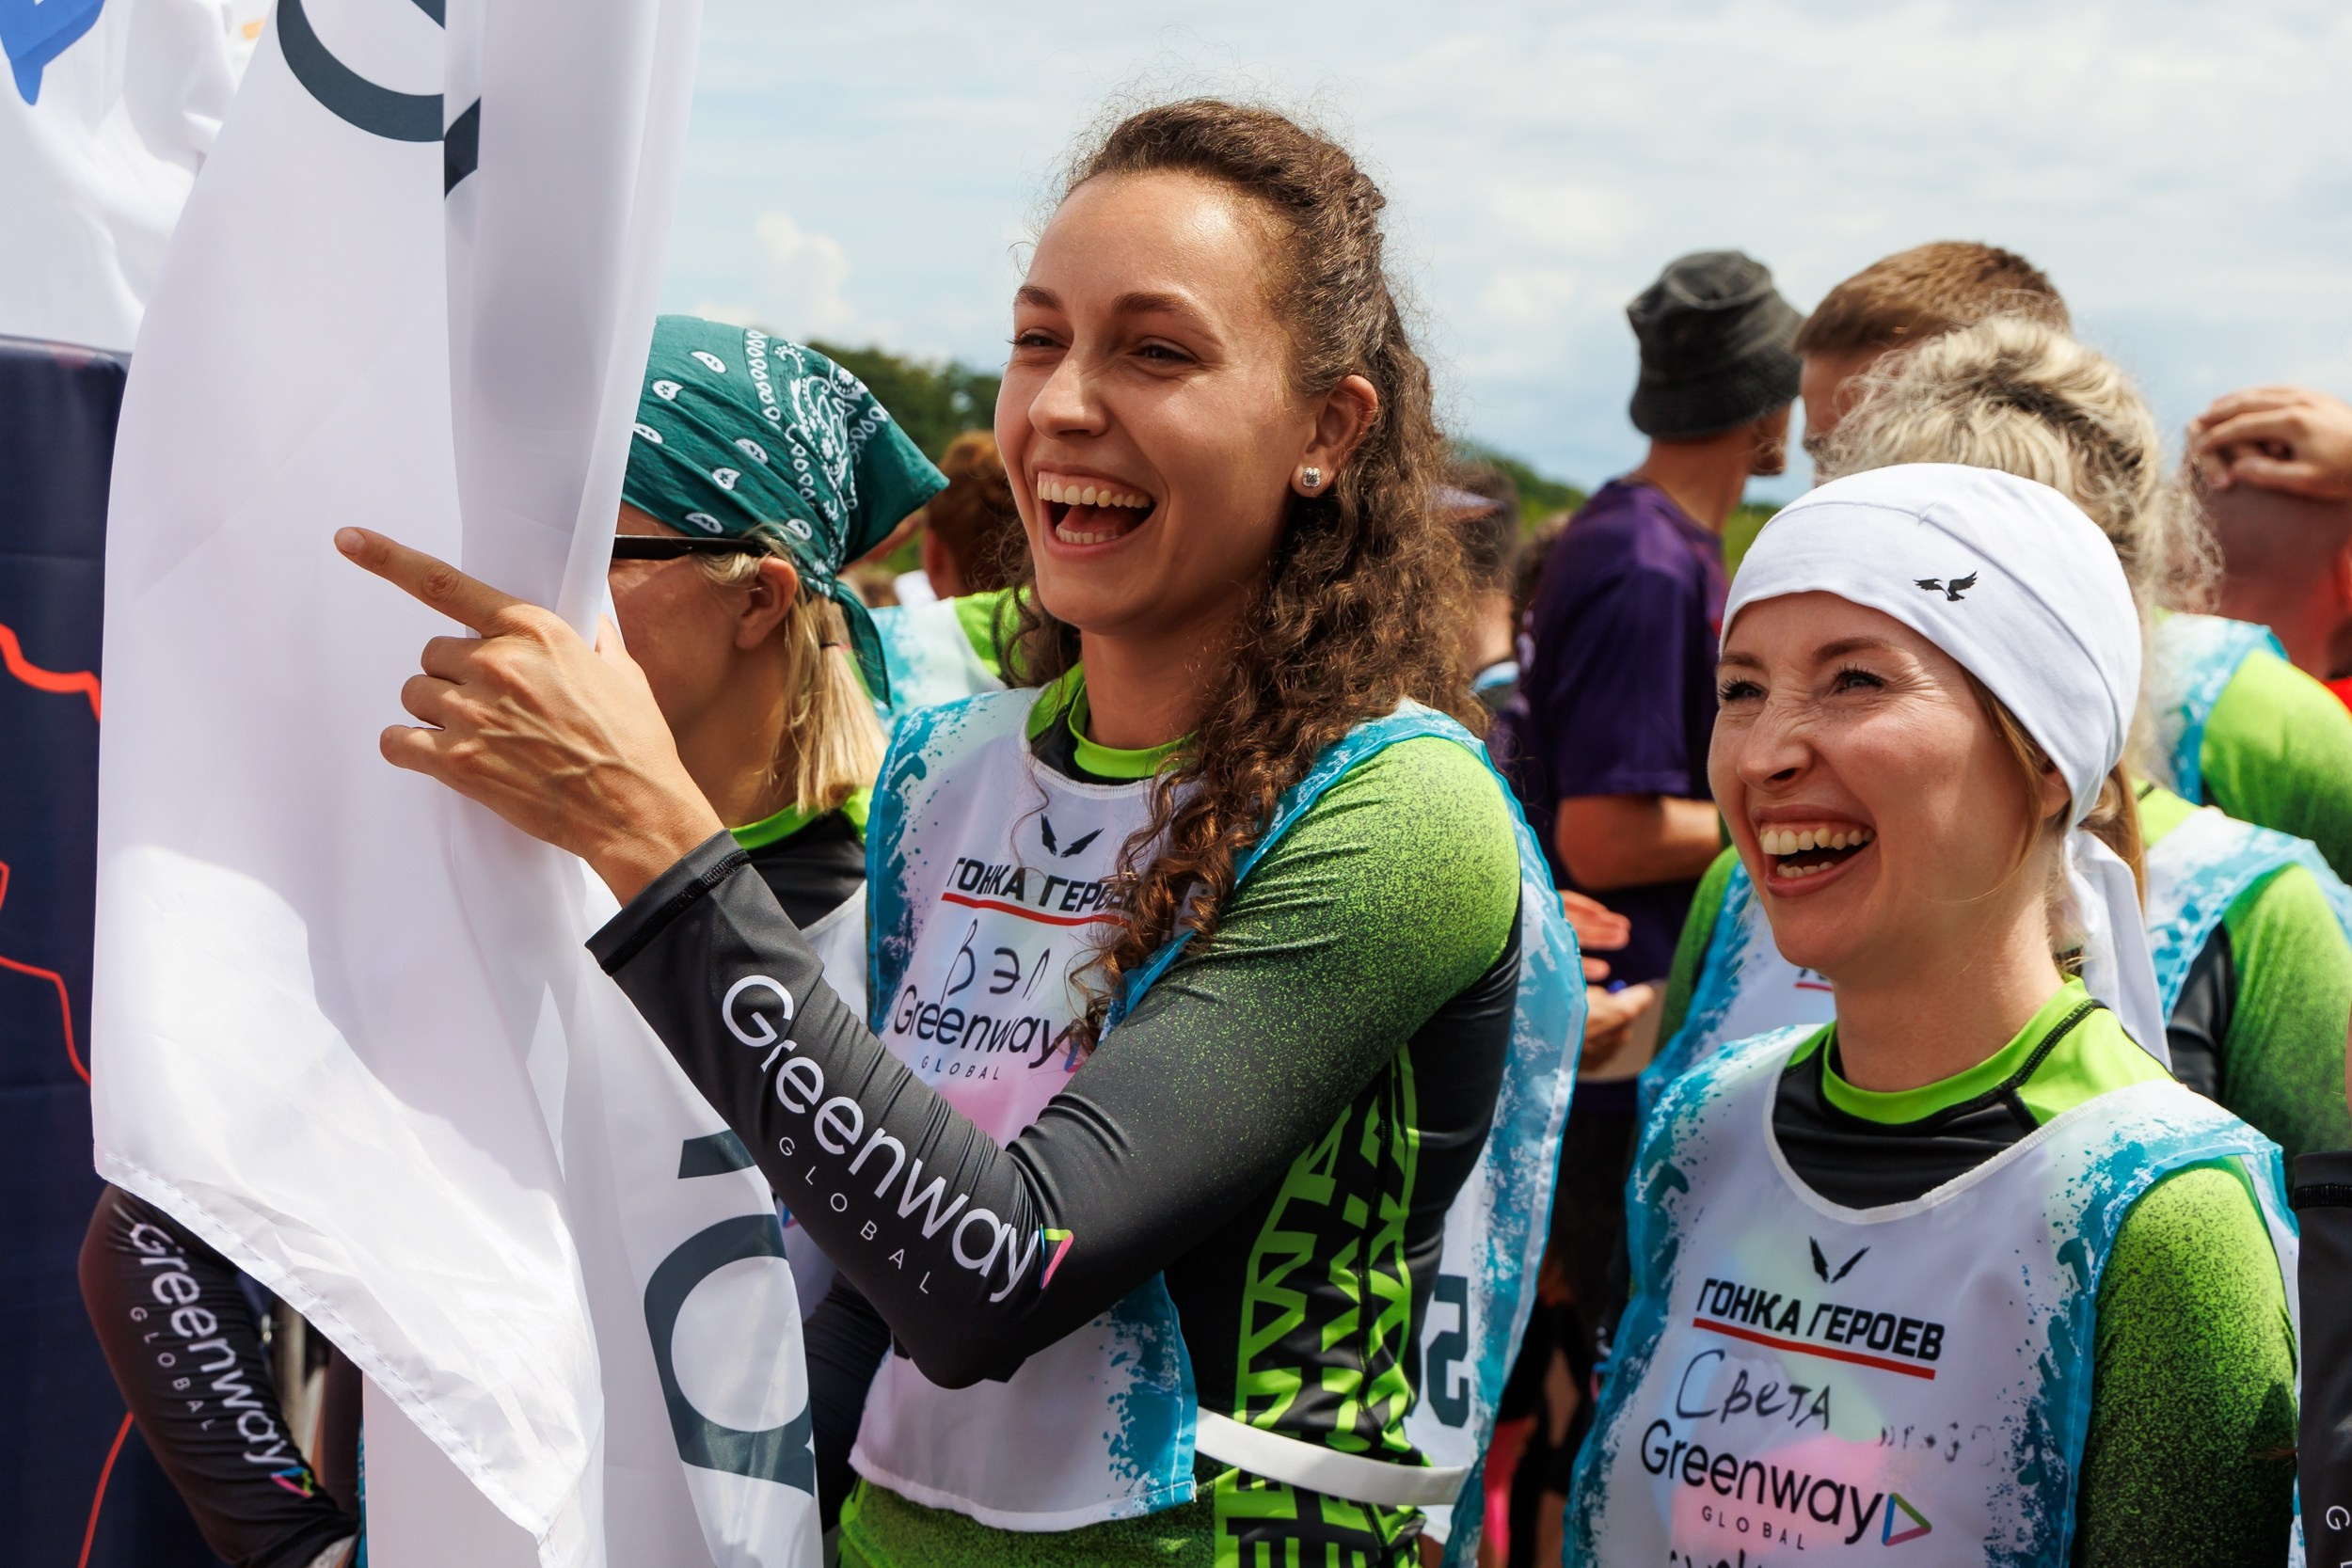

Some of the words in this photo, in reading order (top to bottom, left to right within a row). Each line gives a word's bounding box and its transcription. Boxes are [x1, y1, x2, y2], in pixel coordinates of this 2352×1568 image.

[946, 858, 1025, 901] ГОНКА
[895, 985, 1073, 1069] Greenway
[921, 1055, 999, 1081] GLOBAL
[723, 974, 1040, 1303] Greenway
[779, 1137, 930, 1294] GLOBAL
[130, 1223, 297, 1465] Greenway
[130, 1307, 217, 1431] GLOBAL
[1696, 1278, 1801, 1336] ГОНКА
[1806, 1304, 1945, 1362] ГЕРОЕВ
[1641, 1418, 1884, 1545] Greenway
[1702, 1506, 1804, 1550] GLOBAL
